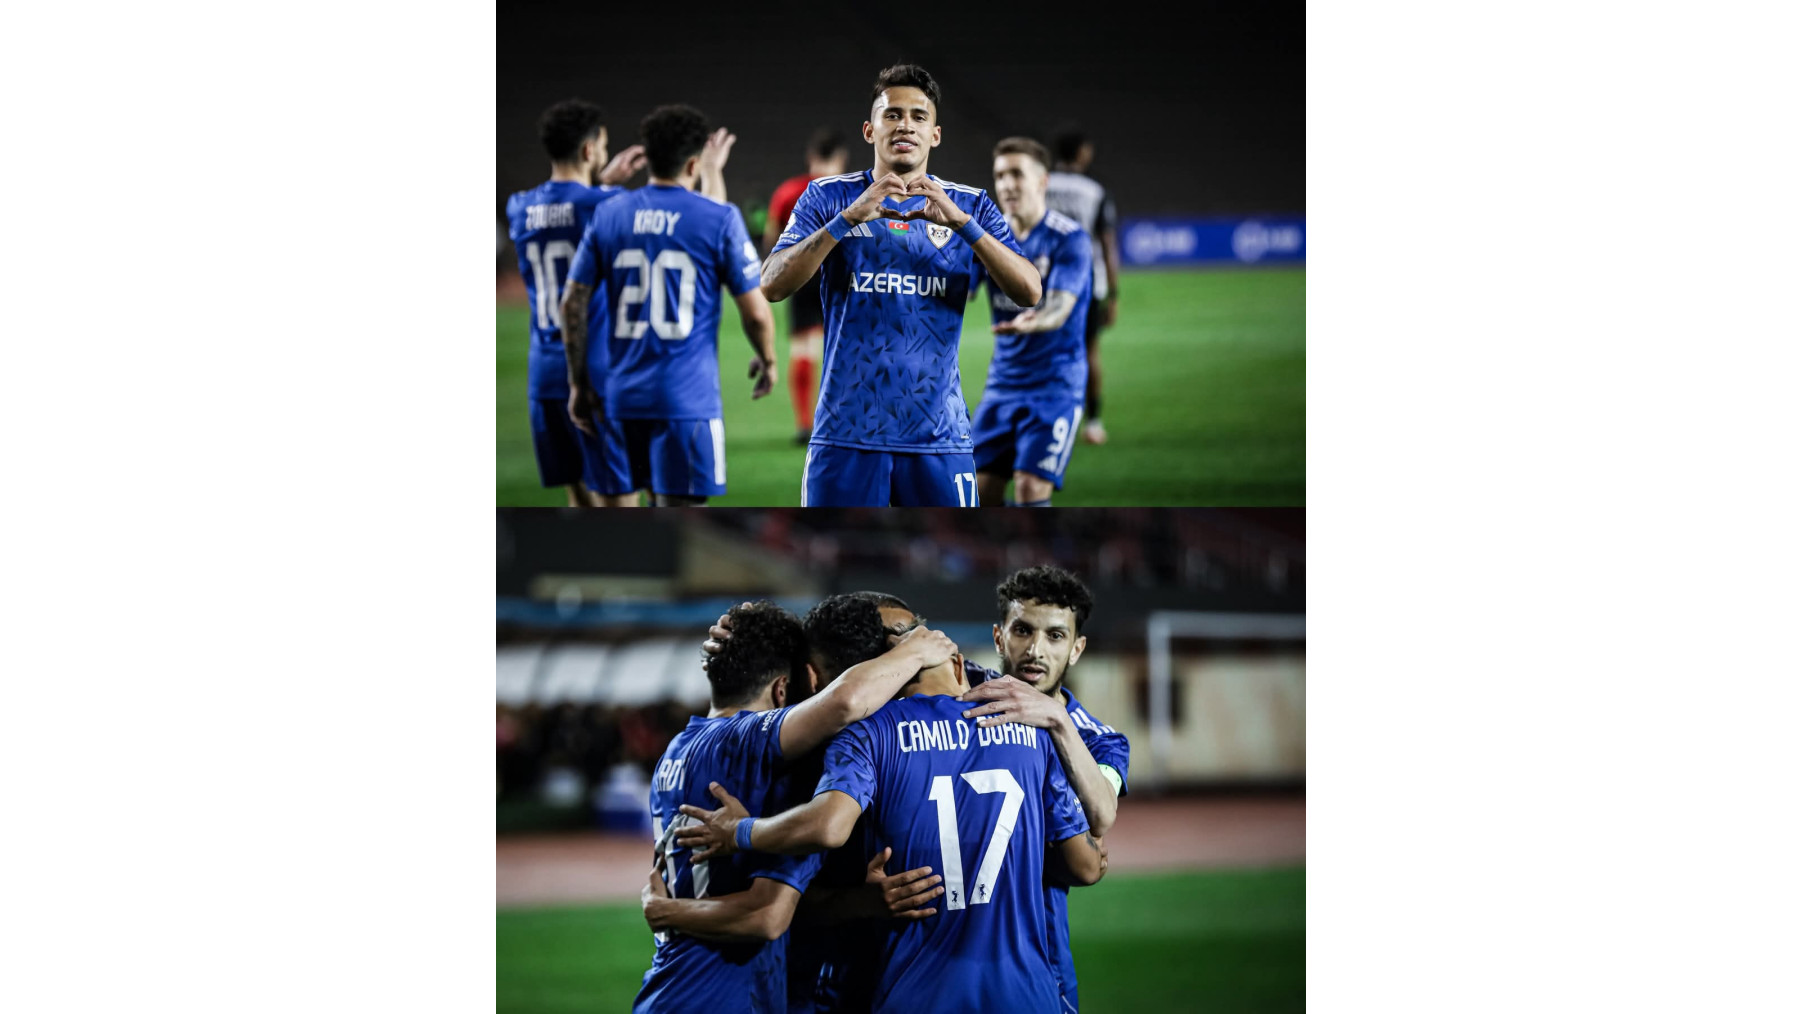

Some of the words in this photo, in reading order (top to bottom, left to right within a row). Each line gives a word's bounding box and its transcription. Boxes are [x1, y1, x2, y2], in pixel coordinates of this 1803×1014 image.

[612, 248, 697, 341] 20
[848, 272, 947, 298] AZERSUN
[1047, 416, 1070, 455] 9
[954, 472, 977, 508] 17
[897, 718, 970, 753] CAMILO
[928, 768, 1026, 911] 17
